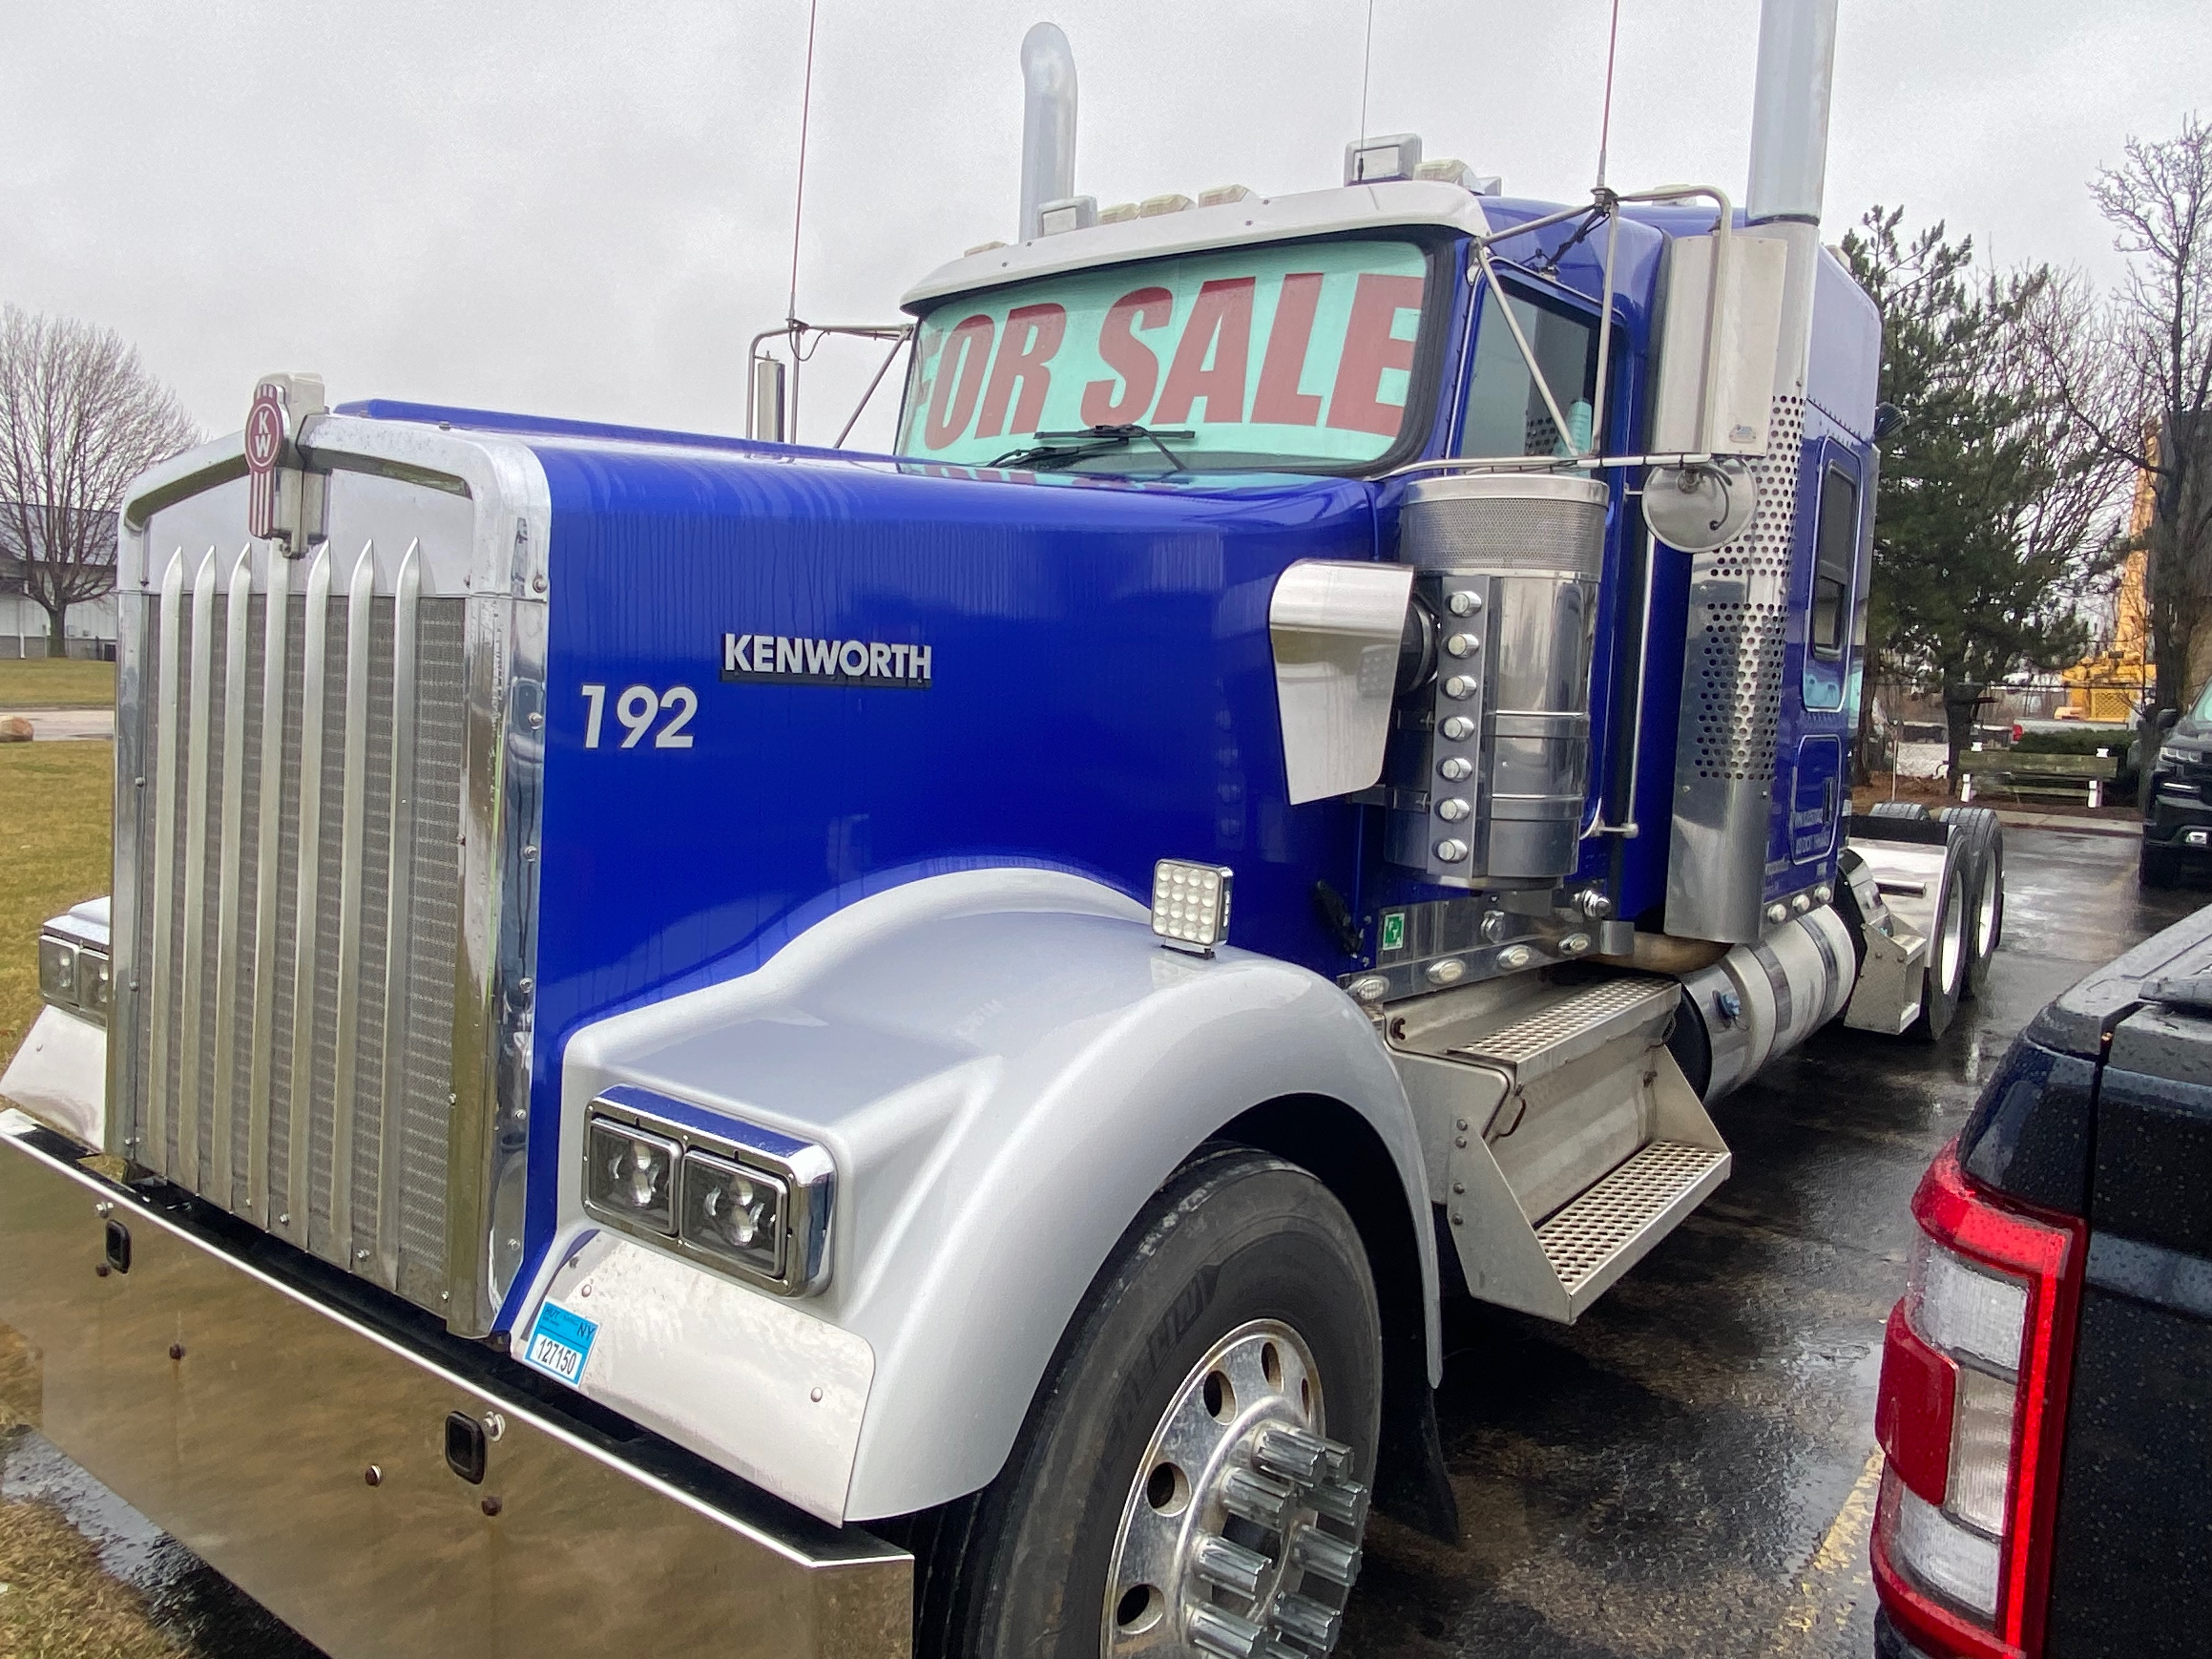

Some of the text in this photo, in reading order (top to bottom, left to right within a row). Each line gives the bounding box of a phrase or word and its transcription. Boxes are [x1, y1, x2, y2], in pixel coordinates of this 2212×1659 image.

[1080, 272, 1425, 437] SALE
[724, 633, 931, 679] KENWORTH
[581, 685, 698, 748] 192
[578, 1323, 596, 1340] NY
[538, 1338, 577, 1375] 127150
